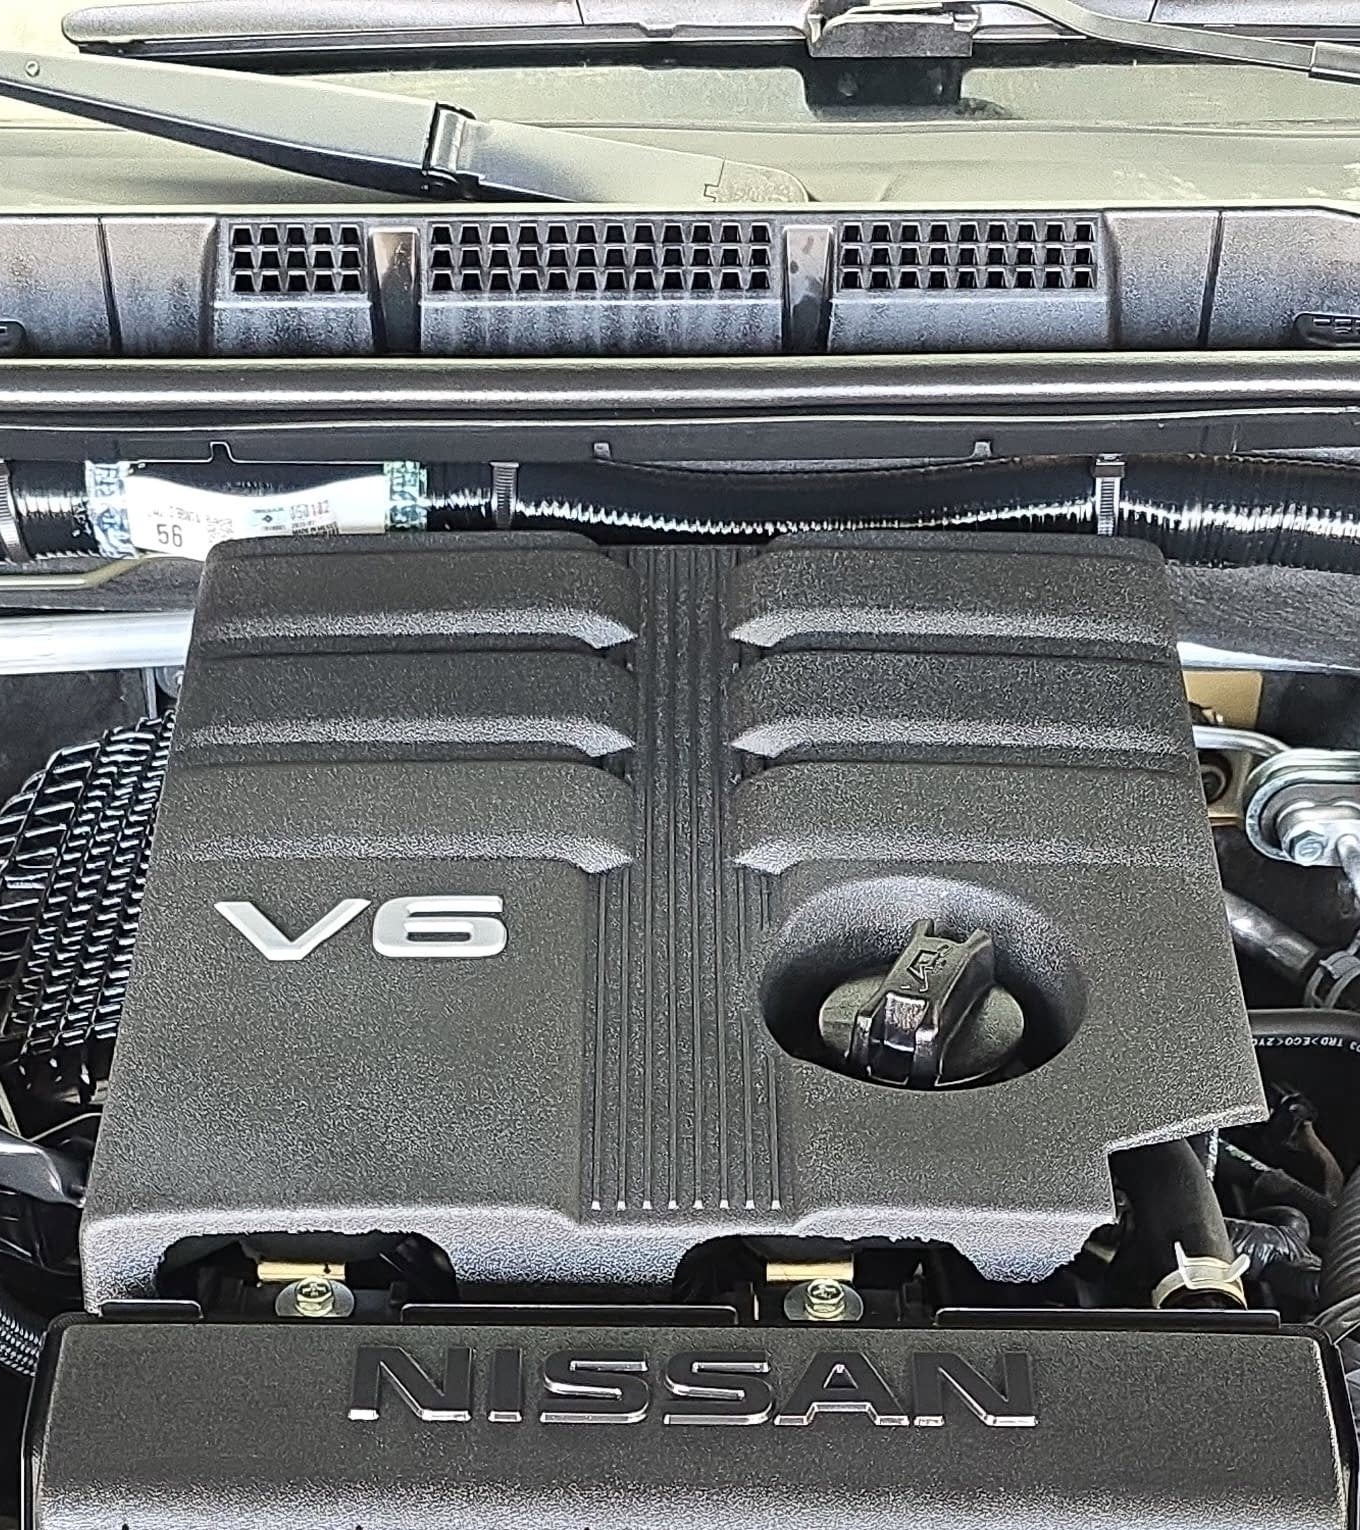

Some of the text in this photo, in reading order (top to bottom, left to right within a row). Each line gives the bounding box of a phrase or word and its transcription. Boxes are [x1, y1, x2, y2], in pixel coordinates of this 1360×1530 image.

[157, 523, 183, 547] 56
[216, 895, 508, 961] V6
[349, 1345, 1038, 1427] NISSAN
